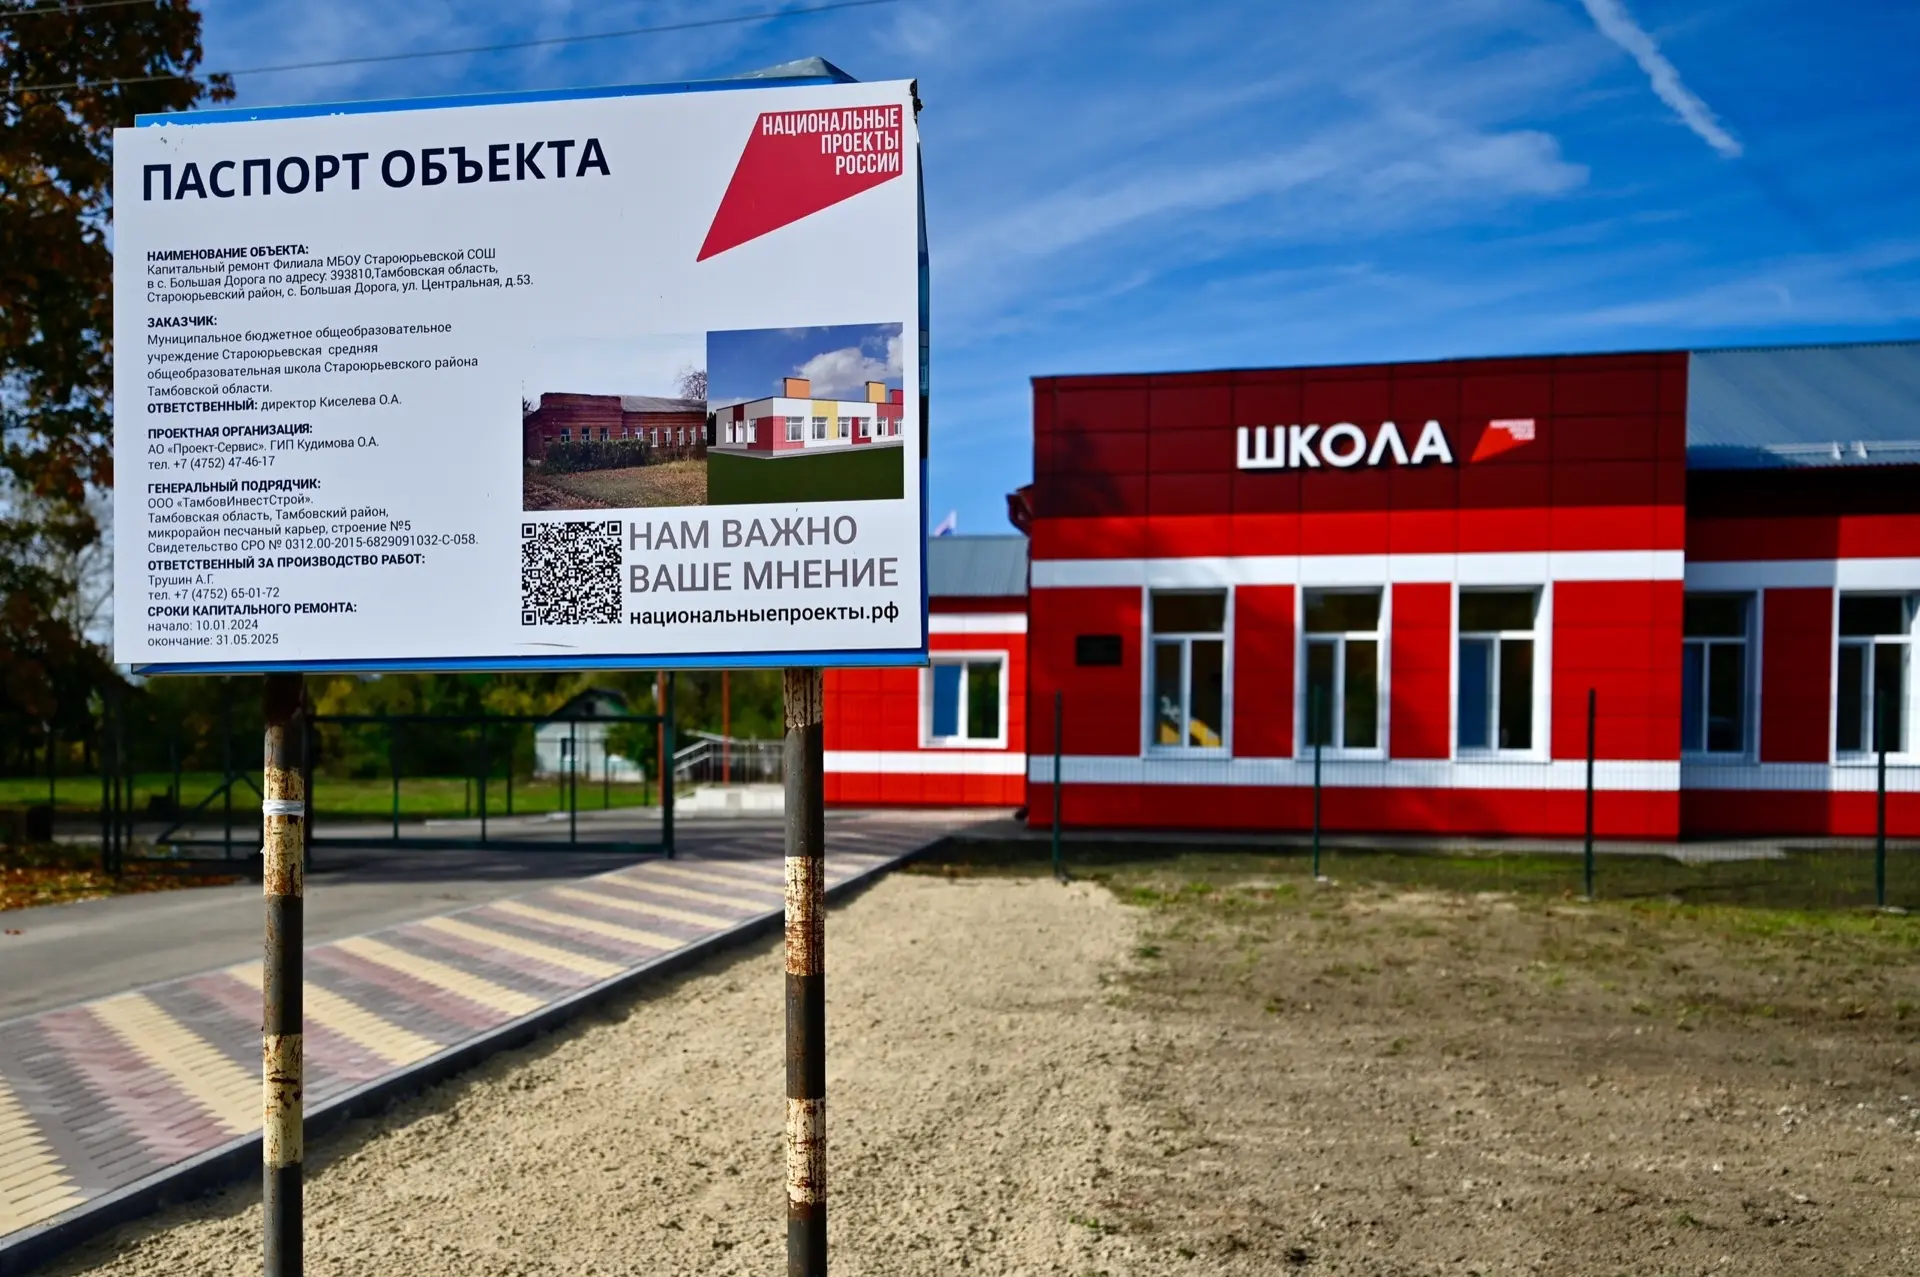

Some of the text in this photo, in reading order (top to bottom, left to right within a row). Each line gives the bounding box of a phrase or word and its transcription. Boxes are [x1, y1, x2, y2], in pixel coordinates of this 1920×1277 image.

[762, 107, 899, 136] НАЦИОНАЛЬНЫЕ
[821, 130, 899, 154] ПРОЕКТЫ
[143, 138, 611, 201] ПАСПОРТ ОБЪЕКТА
[835, 152, 899, 175] РОССИИ
[147, 244, 309, 262] НАИМЕНОВАНИЕ ОБЪЕКТА:
[147, 248, 495, 276] Капитальный ремонт Филиала МБОУ Староюрьевской СОШ
[157, 280, 166, 288] с.
[170, 277, 221, 288] Большая
[224, 275, 266, 288] Дорога
[269, 275, 282, 287] по
[448, 263, 498, 275] область,
[147, 274, 533, 304] Староюрьевский район, с. Большая Дорога, ул. Центральная, д.53.
[147, 315, 218, 328] ЗАКАЗЧИК:
[147, 323, 452, 348] Муниципальное бюджетное общеобразовательное
[147, 344, 378, 365] учреждение Староюрьевская средняя
[147, 356, 478, 381] общеобразовательная школа Староюрьевского района
[147, 382, 273, 397] Тамбовской области.
[147, 393, 402, 414] ОТВЕТСТВЕННЫЙ: директор Киселева О.А.
[148, 423, 313, 440] ПРОЕКТНАЯ ОРГАНИЗАЦИЯ:
[147, 443, 165, 455] АО
[270, 439, 294, 451] ГИП
[297, 438, 355, 452] Кудимова
[357, 436, 379, 448] О.А.
[1236, 419, 1453, 469] ШКОЛА
[148, 455, 275, 472] тел. +7 (4752) 47-46-17
[148, 478, 321, 494] ГЕНЕРАЛЬНЫЙ ПОДРЯДЧИК:
[148, 497, 174, 509] ООО
[148, 506, 389, 524] Тамбовская область, Тамбовский район,
[148, 520, 411, 541] микрорайон песчаный карьер, строение №5
[630, 515, 857, 551] НАМ ВАЖНО
[148, 542, 238, 555] Свидетельство
[241, 539, 266, 551] СРО
[268, 539, 282, 550] №
[147, 553, 425, 571] ОТВЕТСТВЕННЫЙ ЗА ПРОИЗВОДСТВО РАБОТ:
[148, 573, 214, 588] Трушин А.Г.
[630, 557, 898, 594] ВАШЕ МНЕНИЕ
[148, 586, 280, 602] тел. +7 (4752) 65-01-72
[147, 601, 357, 617] СРОКИ КАПИТАЛЬНОГО РЕМОНТА:
[630, 600, 899, 628] национальныепроекты.рф
[148, 618, 259, 632] начало: 10.01.2024
[147, 633, 279, 647] окончание: 31.05.2025
